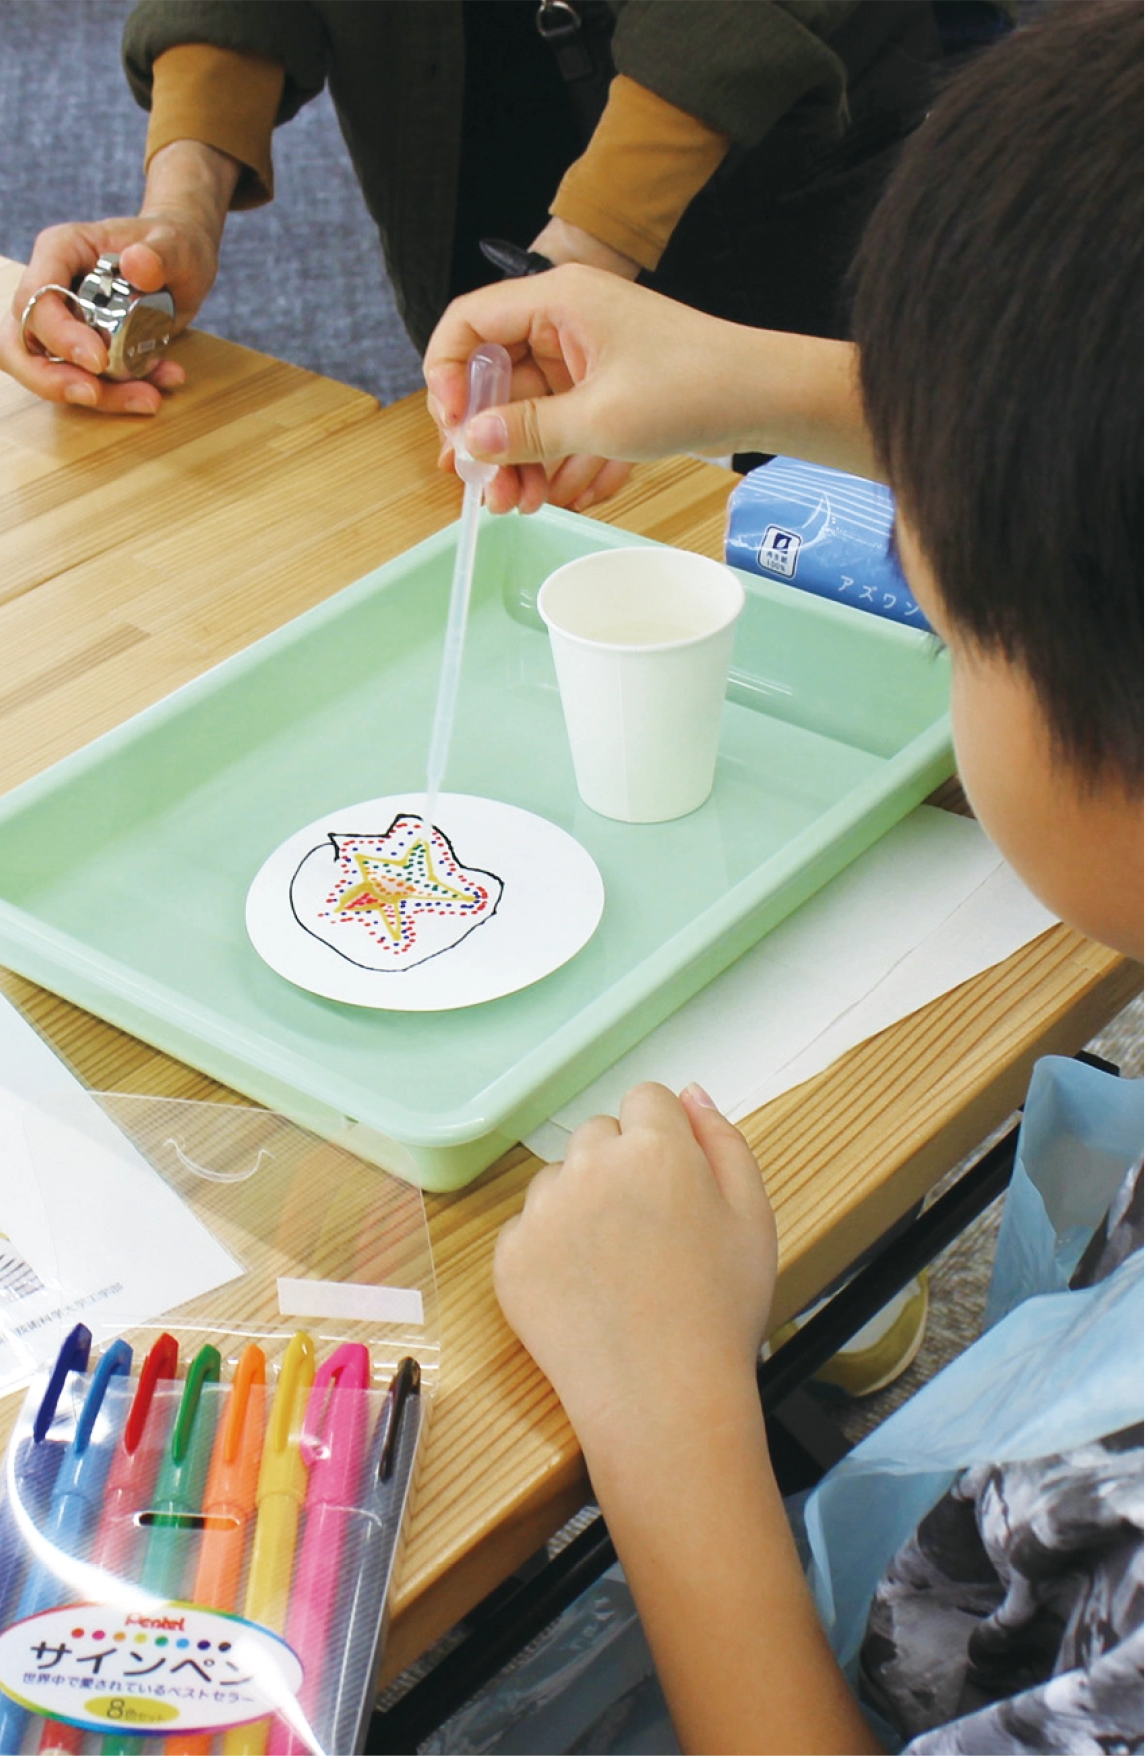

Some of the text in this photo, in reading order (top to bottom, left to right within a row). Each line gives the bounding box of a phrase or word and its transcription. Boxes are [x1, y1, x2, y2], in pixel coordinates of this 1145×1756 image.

[838, 575, 921, 615] アズワン
[124, 1612, 186, 1632] Pentel
[30, 1640, 254, 1687] サインペン
[22, 1671, 254, 1704] 世界中で愛されているベストセラー
